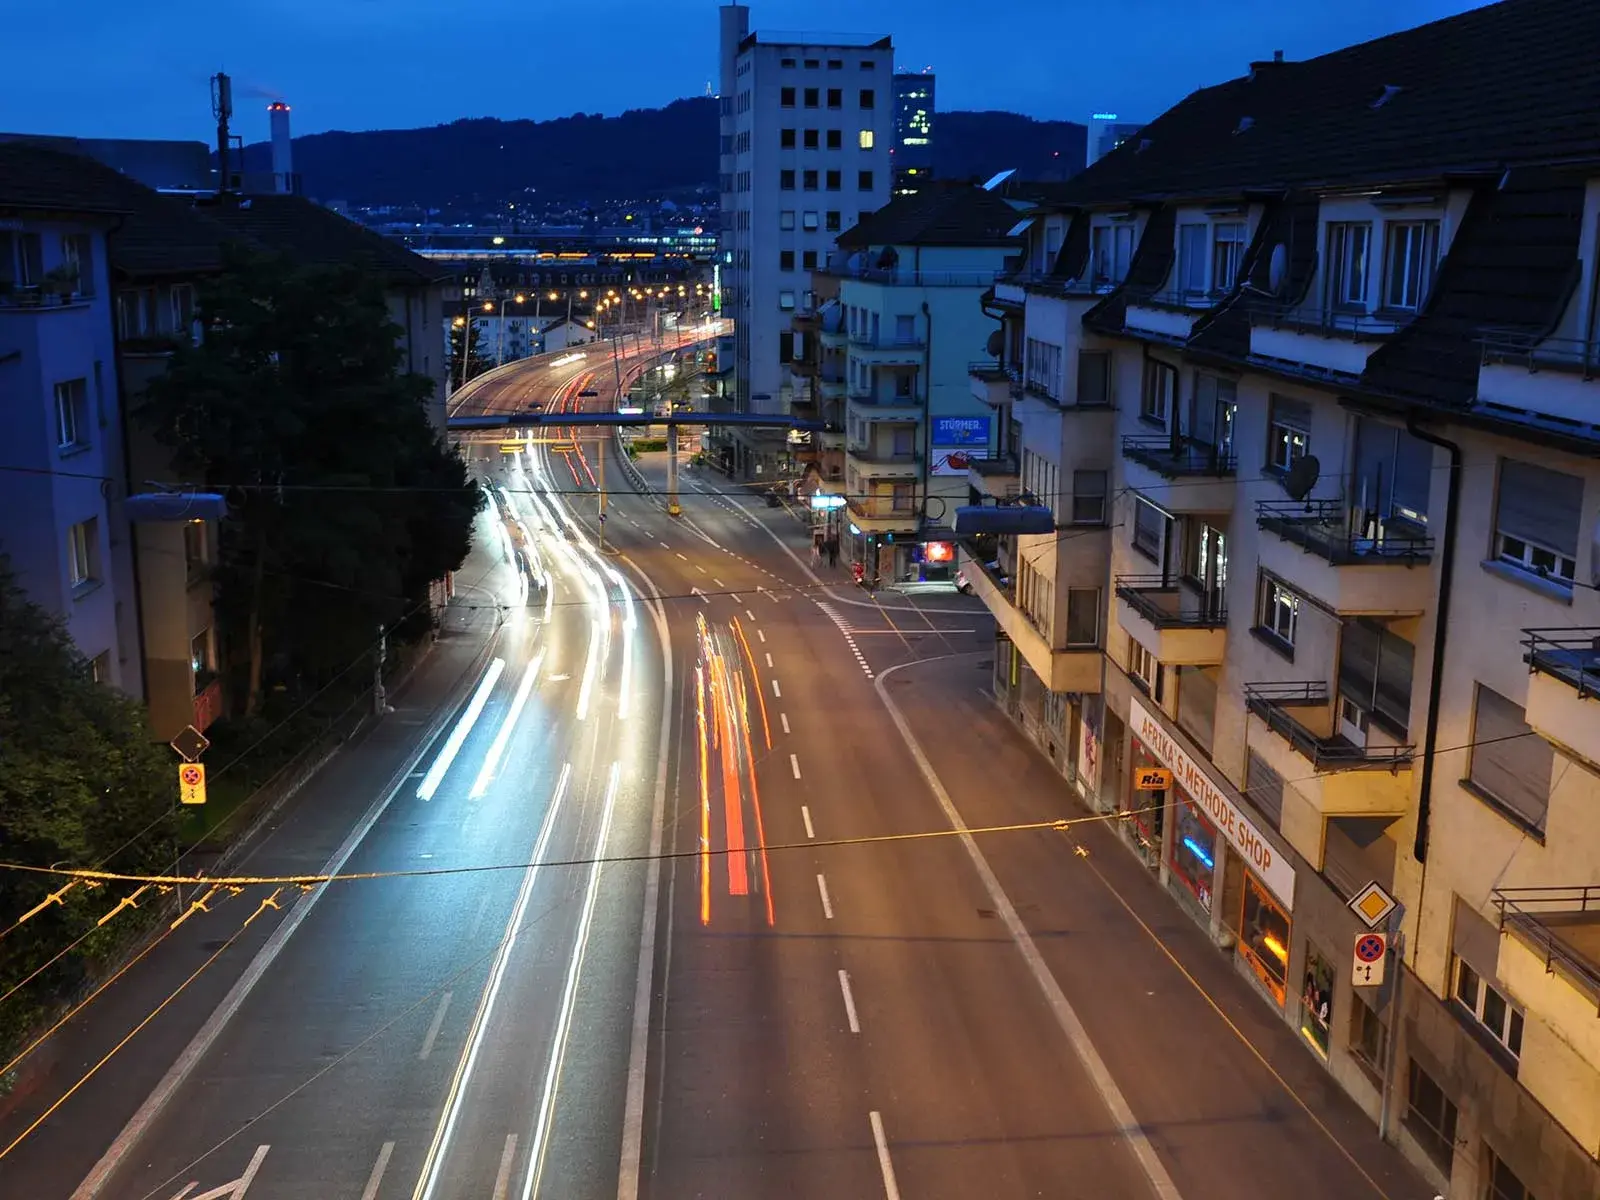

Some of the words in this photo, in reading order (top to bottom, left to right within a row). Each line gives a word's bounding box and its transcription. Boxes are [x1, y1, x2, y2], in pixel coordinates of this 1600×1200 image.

[1141, 771, 1165, 785] Ria
[1185, 763, 1235, 835] METHODE
[1238, 822, 1271, 873] SHOP
